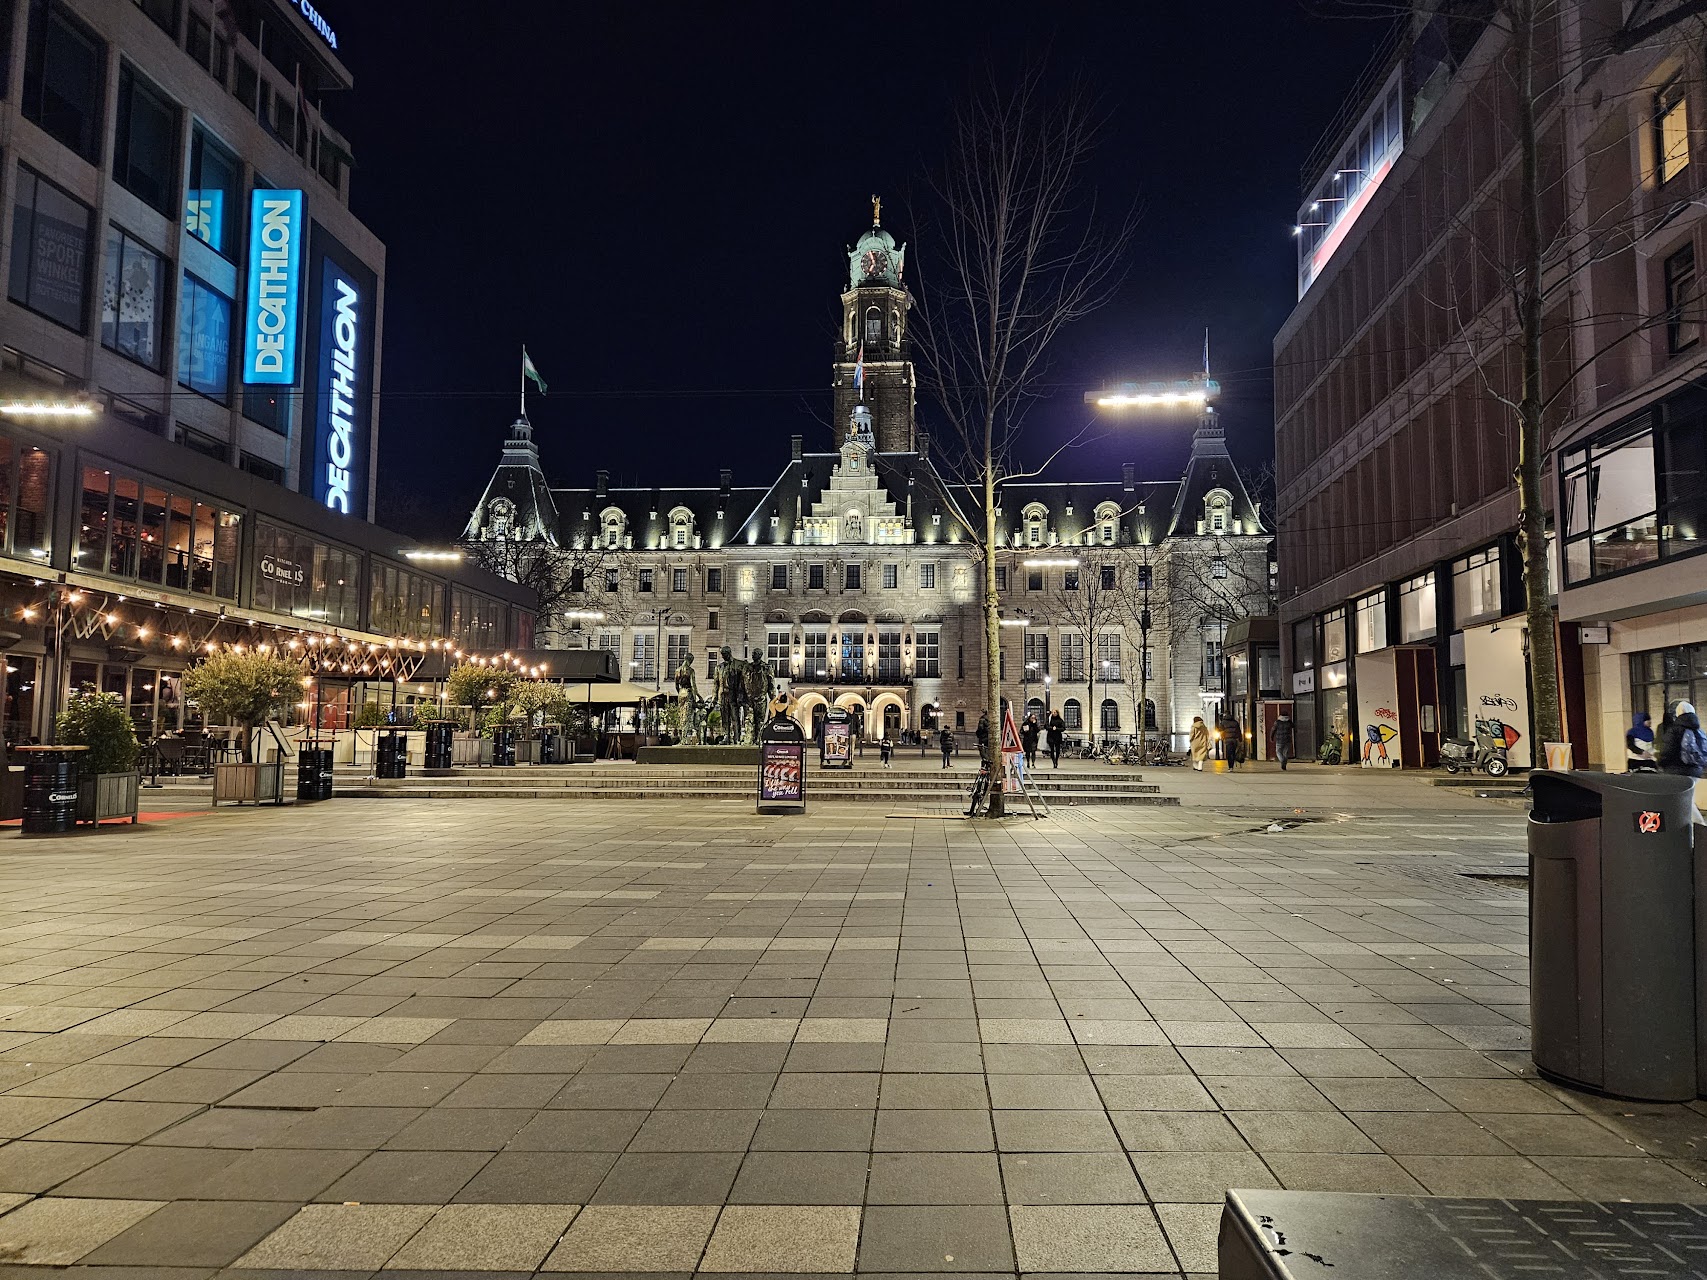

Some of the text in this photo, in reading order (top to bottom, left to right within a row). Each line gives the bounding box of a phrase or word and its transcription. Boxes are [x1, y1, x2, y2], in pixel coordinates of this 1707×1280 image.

[300, 0, 338, 49] CHINA
[36, 257, 81, 285] WINKEL
[37, 237, 85, 268] SPORT
[254, 199, 291, 373] DECATHLON
[326, 278, 358, 514] DECATHLON
